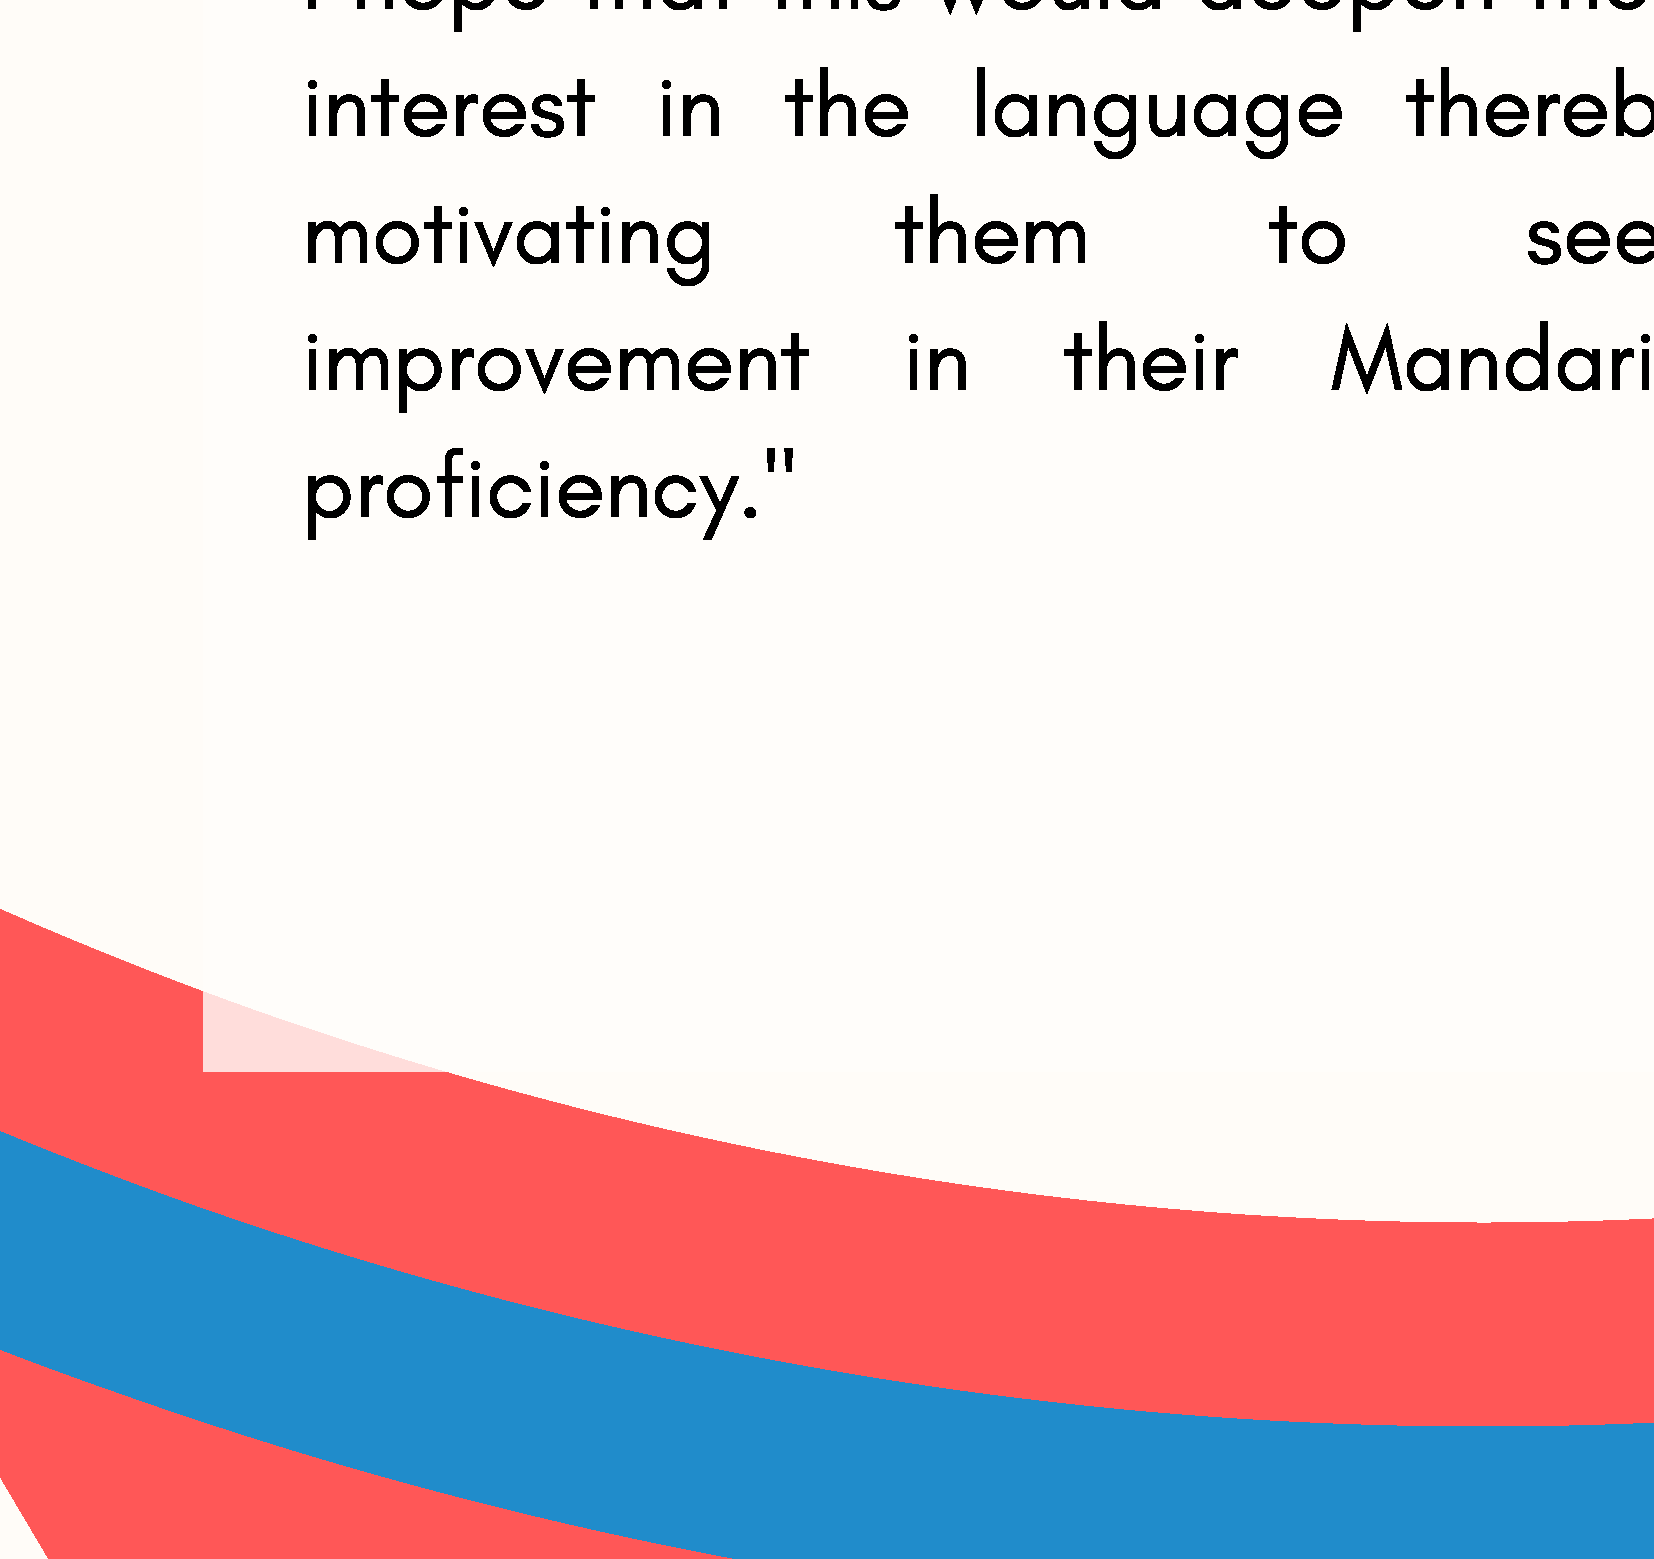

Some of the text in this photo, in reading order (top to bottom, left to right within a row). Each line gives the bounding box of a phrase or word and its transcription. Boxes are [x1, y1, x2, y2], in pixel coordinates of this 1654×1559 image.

[308, 79, 595, 138] interest
[662, 80, 719, 136] in
[785, 67, 908, 137] the
[977, 67, 1342, 159] language
[308, 206, 709, 286] motivating
[895, 194, 1085, 264] them
[1269, 206, 1345, 264] to
[308, 333, 809, 413] improvement
[909, 334, 966, 390] in
[1064, 321, 1238, 391] their
[308, 448, 793, 540] proficiency."
